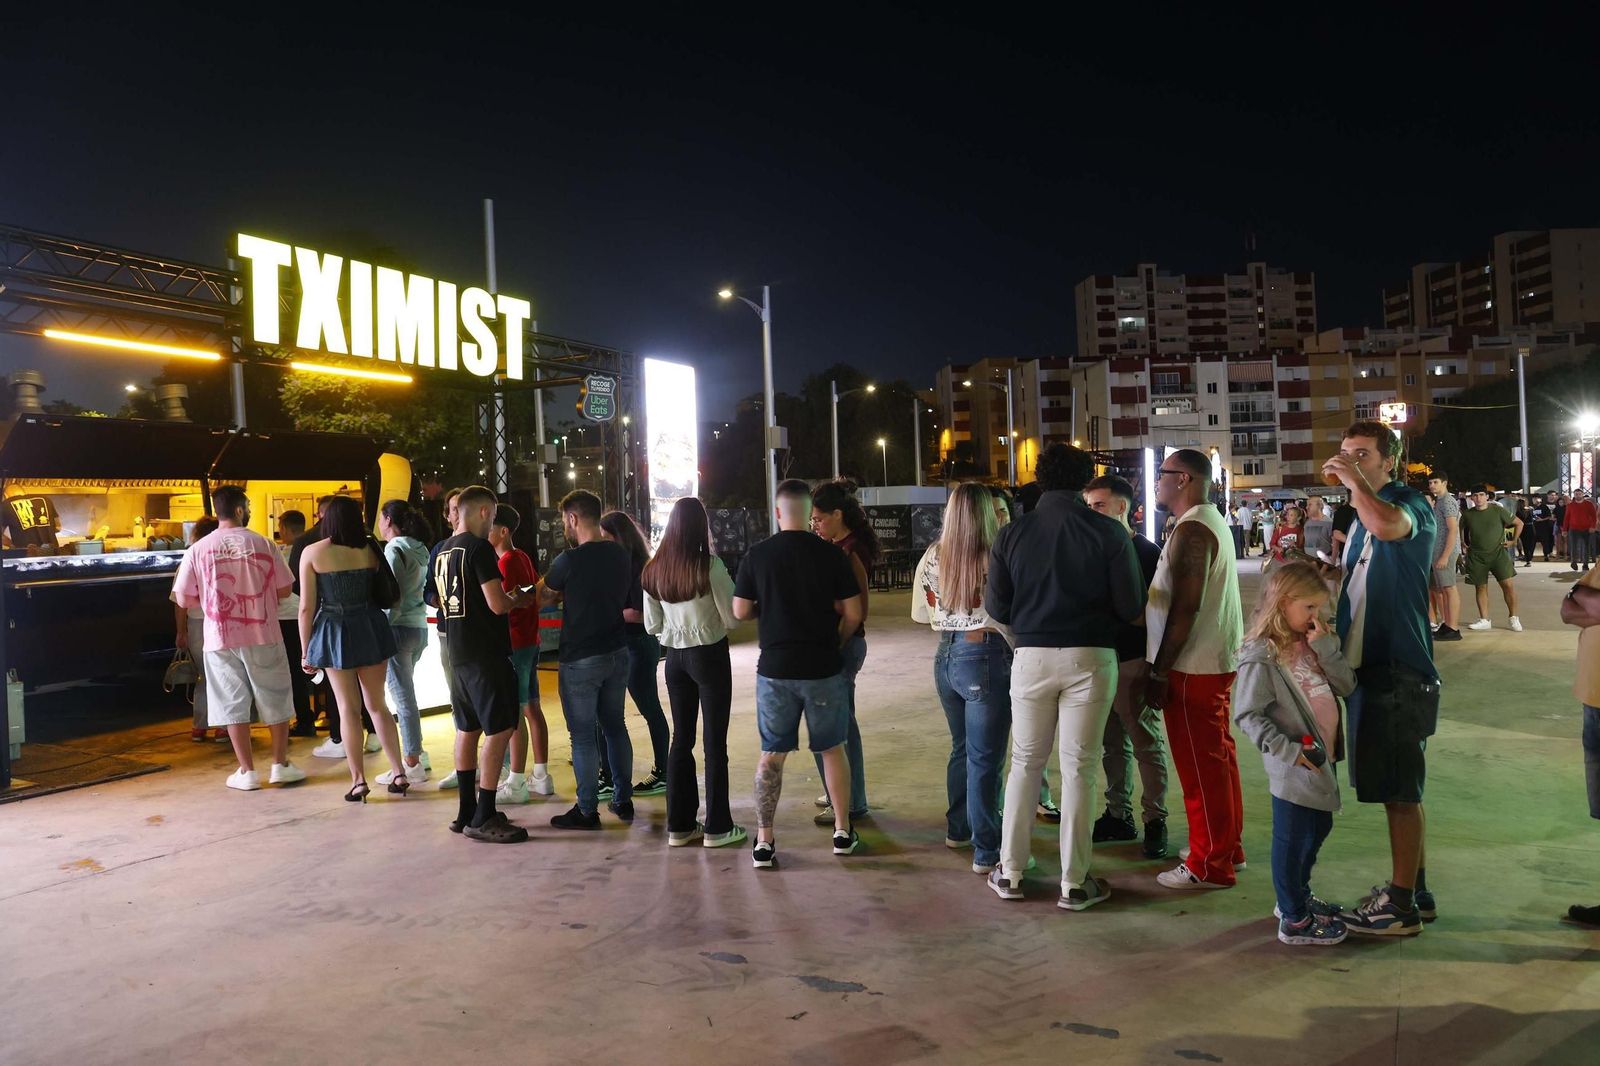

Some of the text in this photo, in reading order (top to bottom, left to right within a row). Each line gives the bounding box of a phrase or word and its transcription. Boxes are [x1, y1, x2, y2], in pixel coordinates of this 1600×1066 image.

[237, 233, 531, 381] TXIMIST
[591, 395, 608, 404] Uber
[591, 405, 607, 414] Eats
